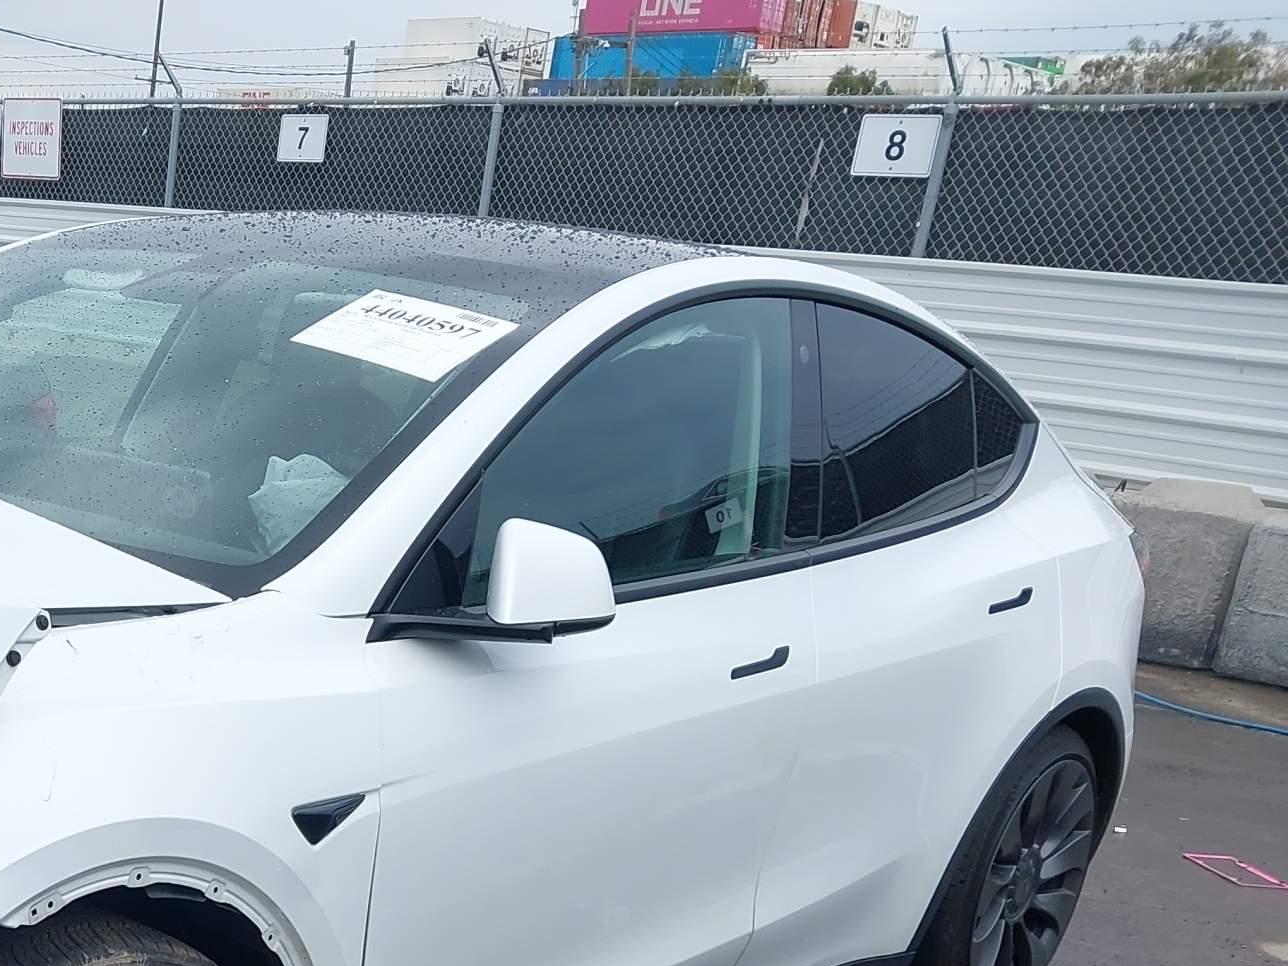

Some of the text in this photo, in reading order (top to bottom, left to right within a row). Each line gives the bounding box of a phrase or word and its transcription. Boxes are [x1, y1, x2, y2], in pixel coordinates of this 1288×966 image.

[9, 121, 54, 136] INSPECTIONS
[297, 127, 310, 151] 7
[14, 141, 47, 156] VEHICLES
[885, 129, 907, 161] 8
[360, 304, 483, 339] 44040597
